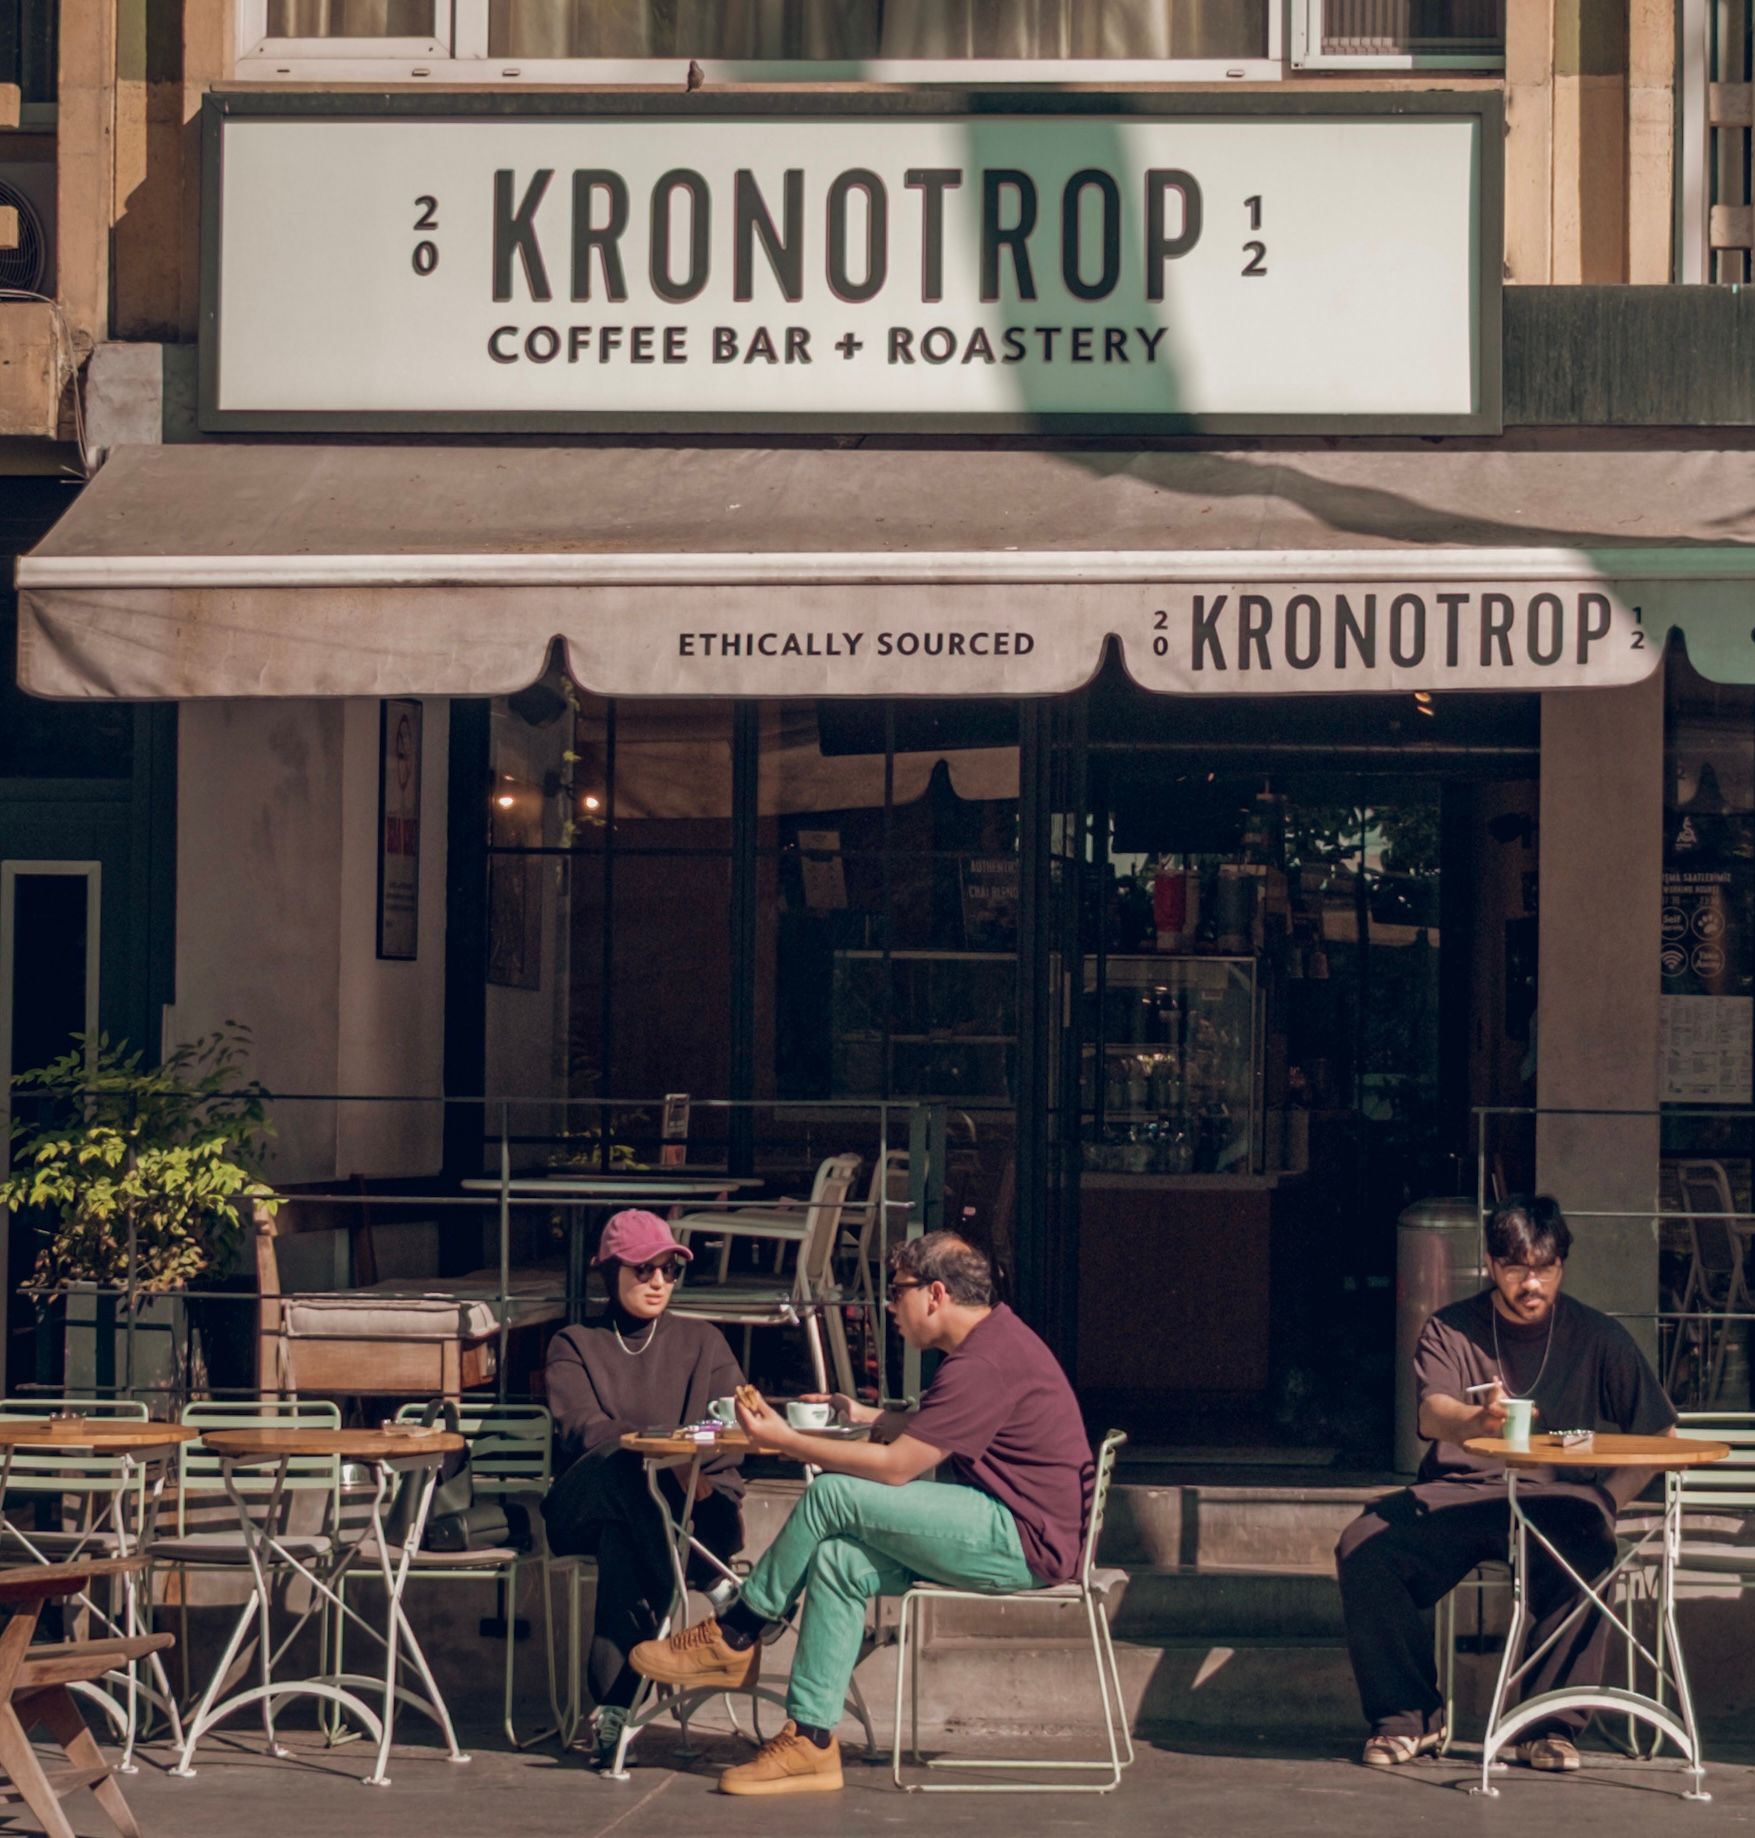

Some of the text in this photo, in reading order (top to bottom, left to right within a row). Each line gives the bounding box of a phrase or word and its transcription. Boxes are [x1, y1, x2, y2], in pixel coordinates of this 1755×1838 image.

[493, 167, 1204, 304] KRONOTROP
[488, 326, 1169, 365] COFFEE BAR + ROASTERY
[679, 631, 1035, 657] ETHICALLY SOURCED
[1192, 593, 1612, 671] KRONOTROP
